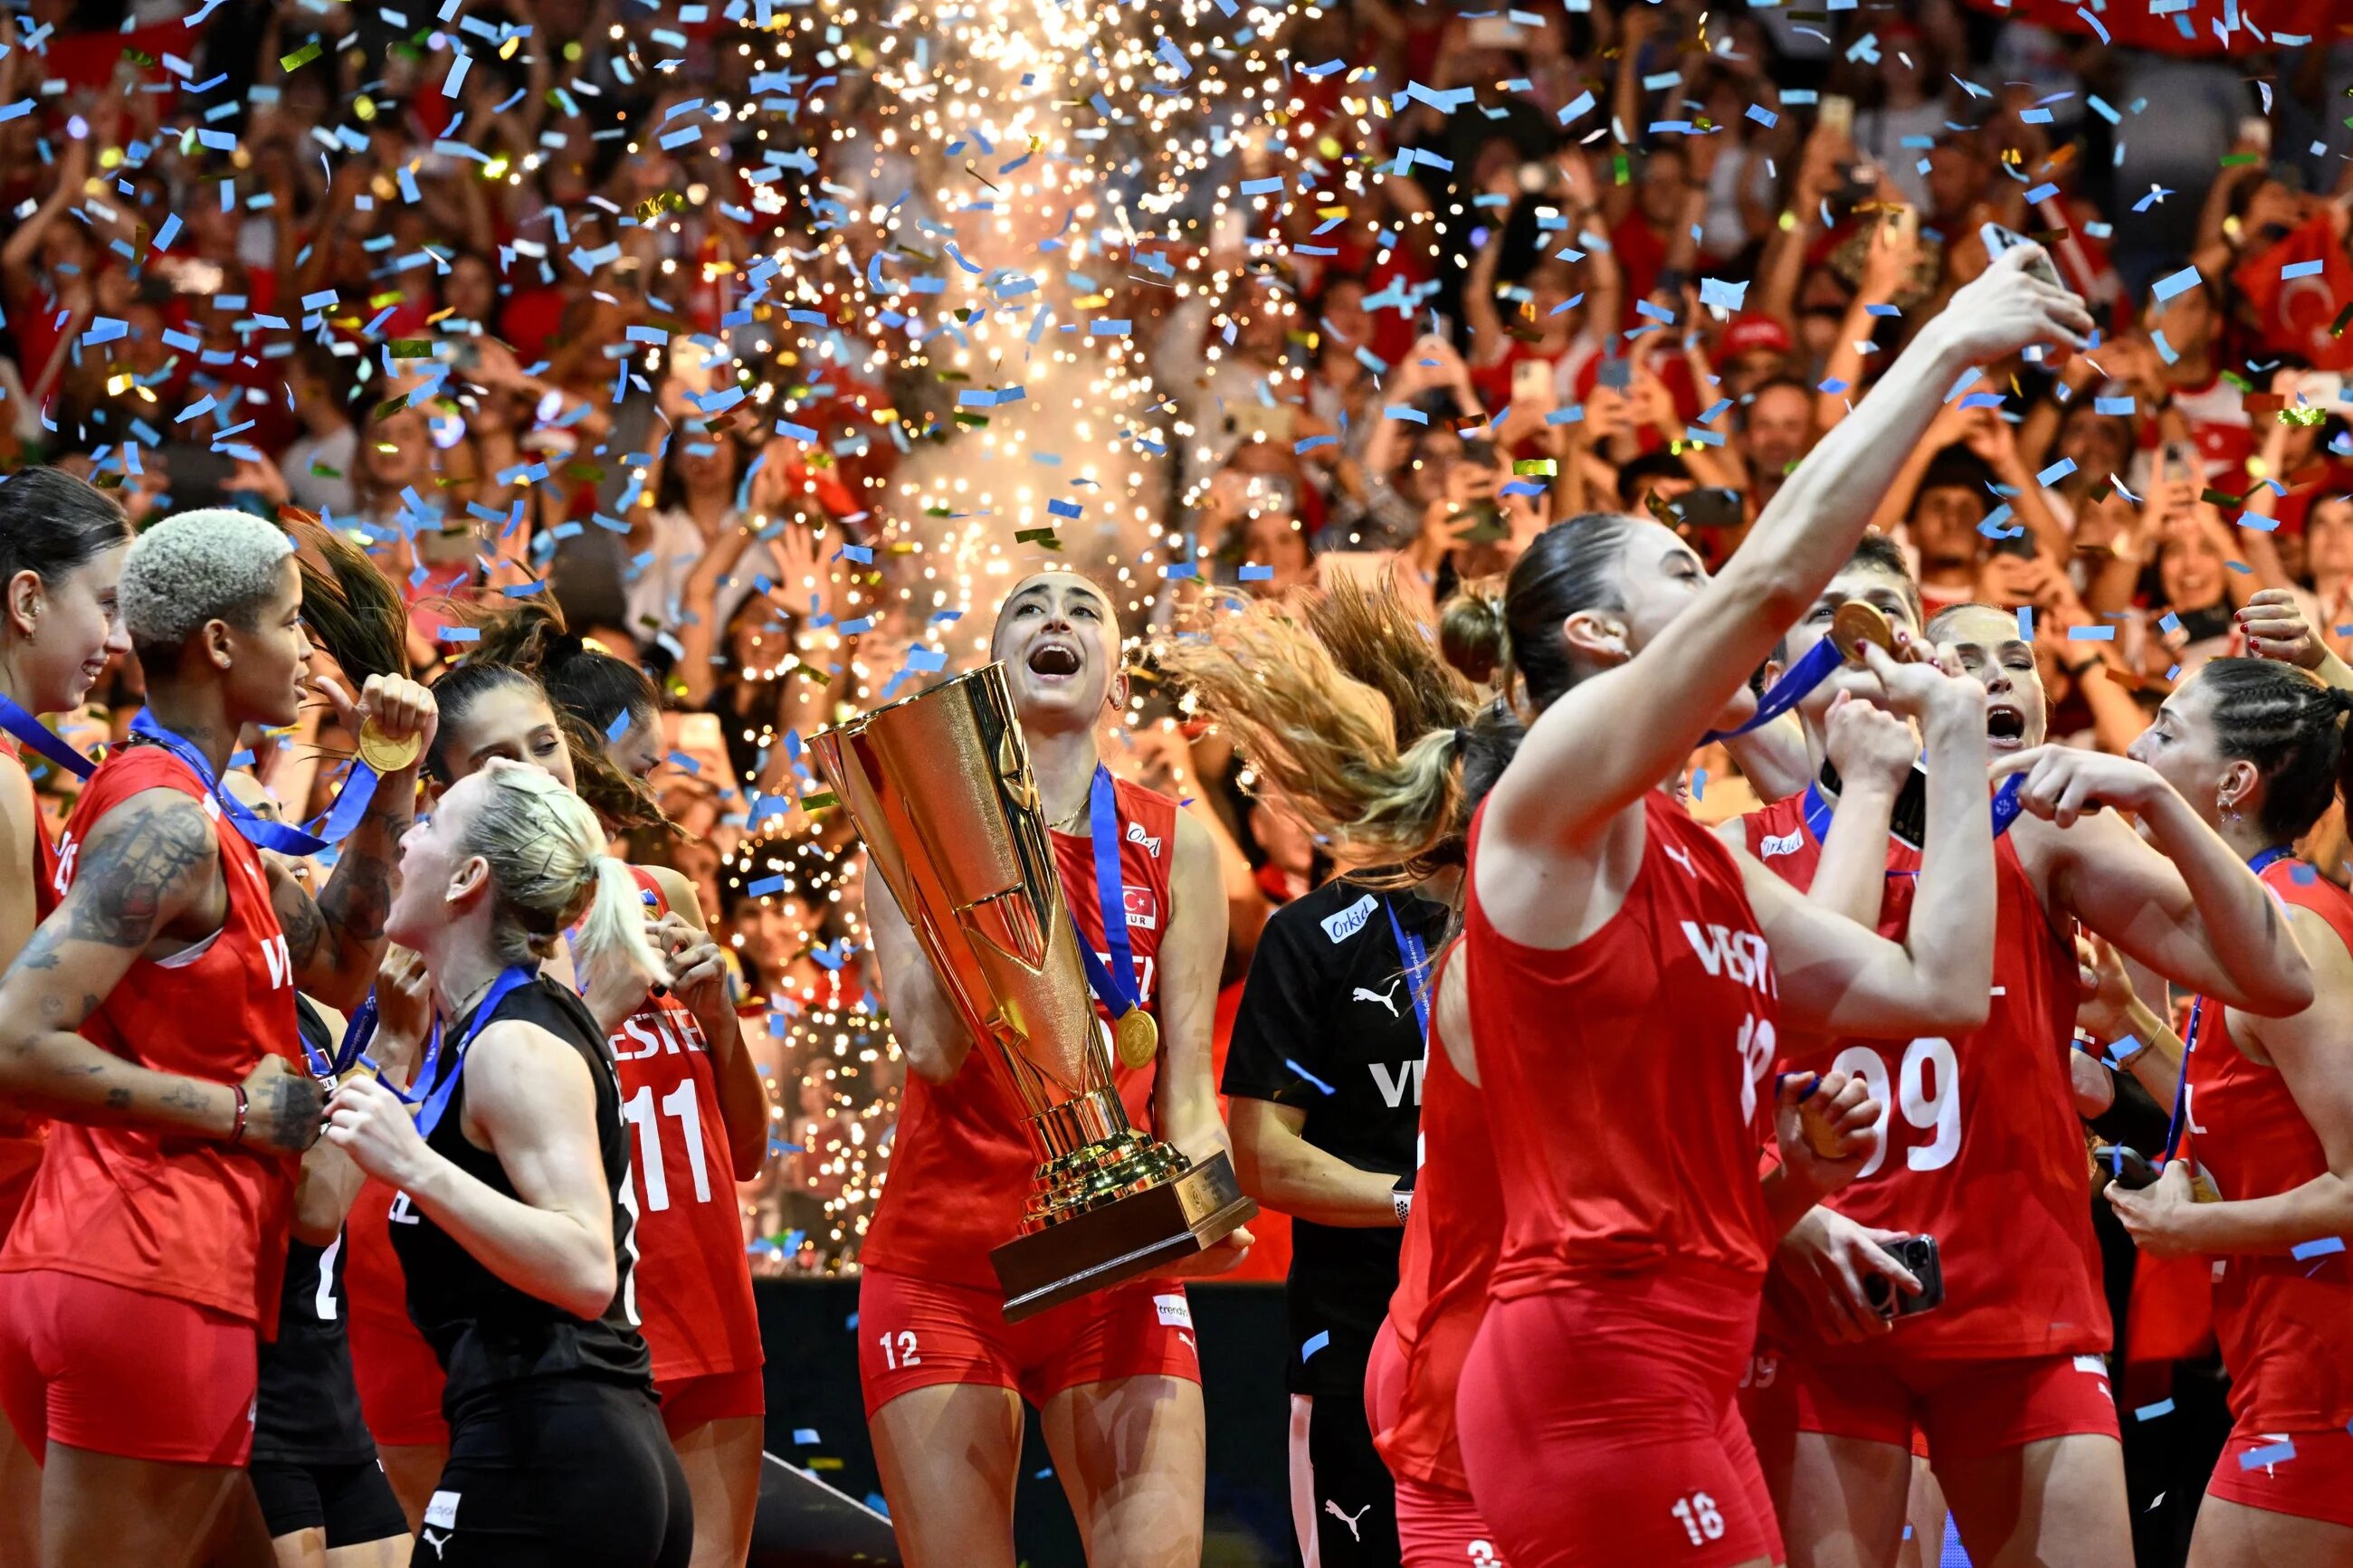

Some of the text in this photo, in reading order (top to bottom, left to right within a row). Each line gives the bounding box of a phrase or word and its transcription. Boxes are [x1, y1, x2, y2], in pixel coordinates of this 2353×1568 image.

[1332, 901, 1369, 938] Orkid
[623, 1078, 711, 1212] 11
[879, 1330, 921, 1370] 12
[1672, 1491, 1725, 1546] 16
